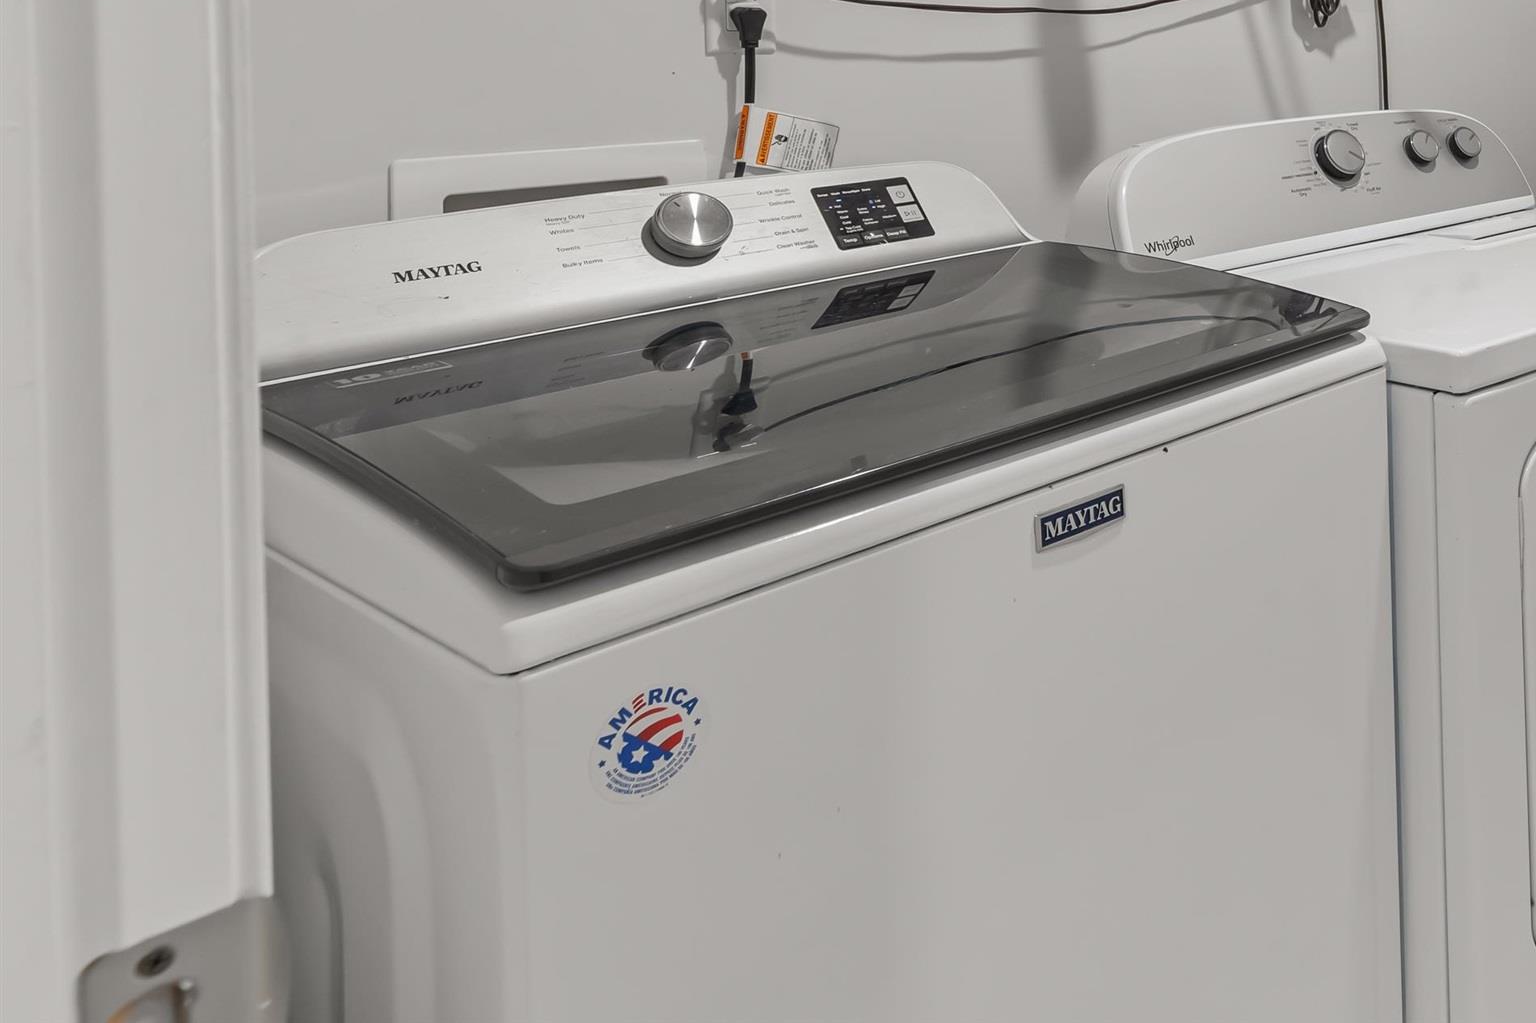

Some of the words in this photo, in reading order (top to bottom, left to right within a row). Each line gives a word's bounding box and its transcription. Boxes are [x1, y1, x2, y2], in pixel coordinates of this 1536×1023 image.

[1144, 234, 1195, 256] Whirlpool
[392, 260, 482, 284] MAYTAG
[1044, 495, 1122, 541] MAYTAG
[598, 686, 699, 751] AMERICA
